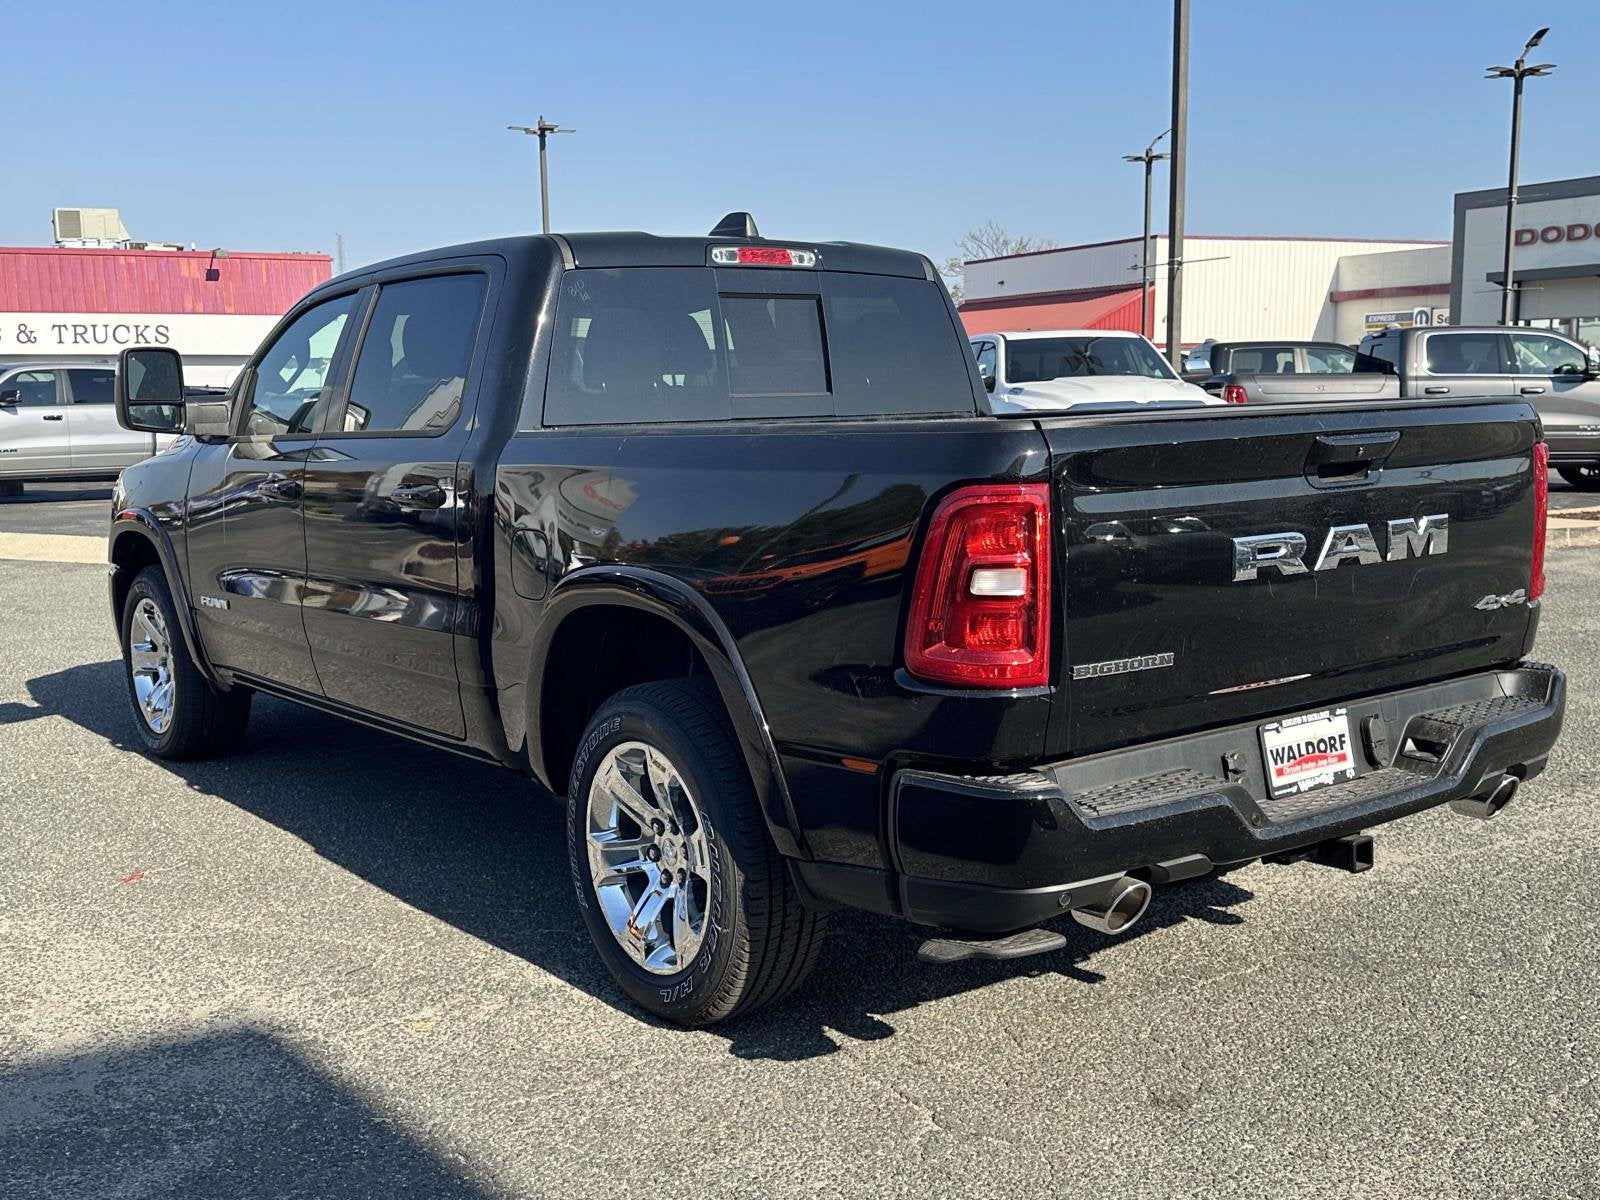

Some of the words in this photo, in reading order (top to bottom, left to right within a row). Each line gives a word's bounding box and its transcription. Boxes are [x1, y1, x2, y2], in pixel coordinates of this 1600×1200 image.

[1368, 314, 1396, 322] EXPRESS
[16, 323, 37, 344] &
[52, 324, 170, 344] TRUCKS
[1232, 513, 1449, 583] RAM
[200, 595, 231, 610] RAM
[1073, 652, 1175, 680] BIGHORN
[1269, 733, 1346, 766] WALDORF
[660, 975, 693, 1003] H/L
